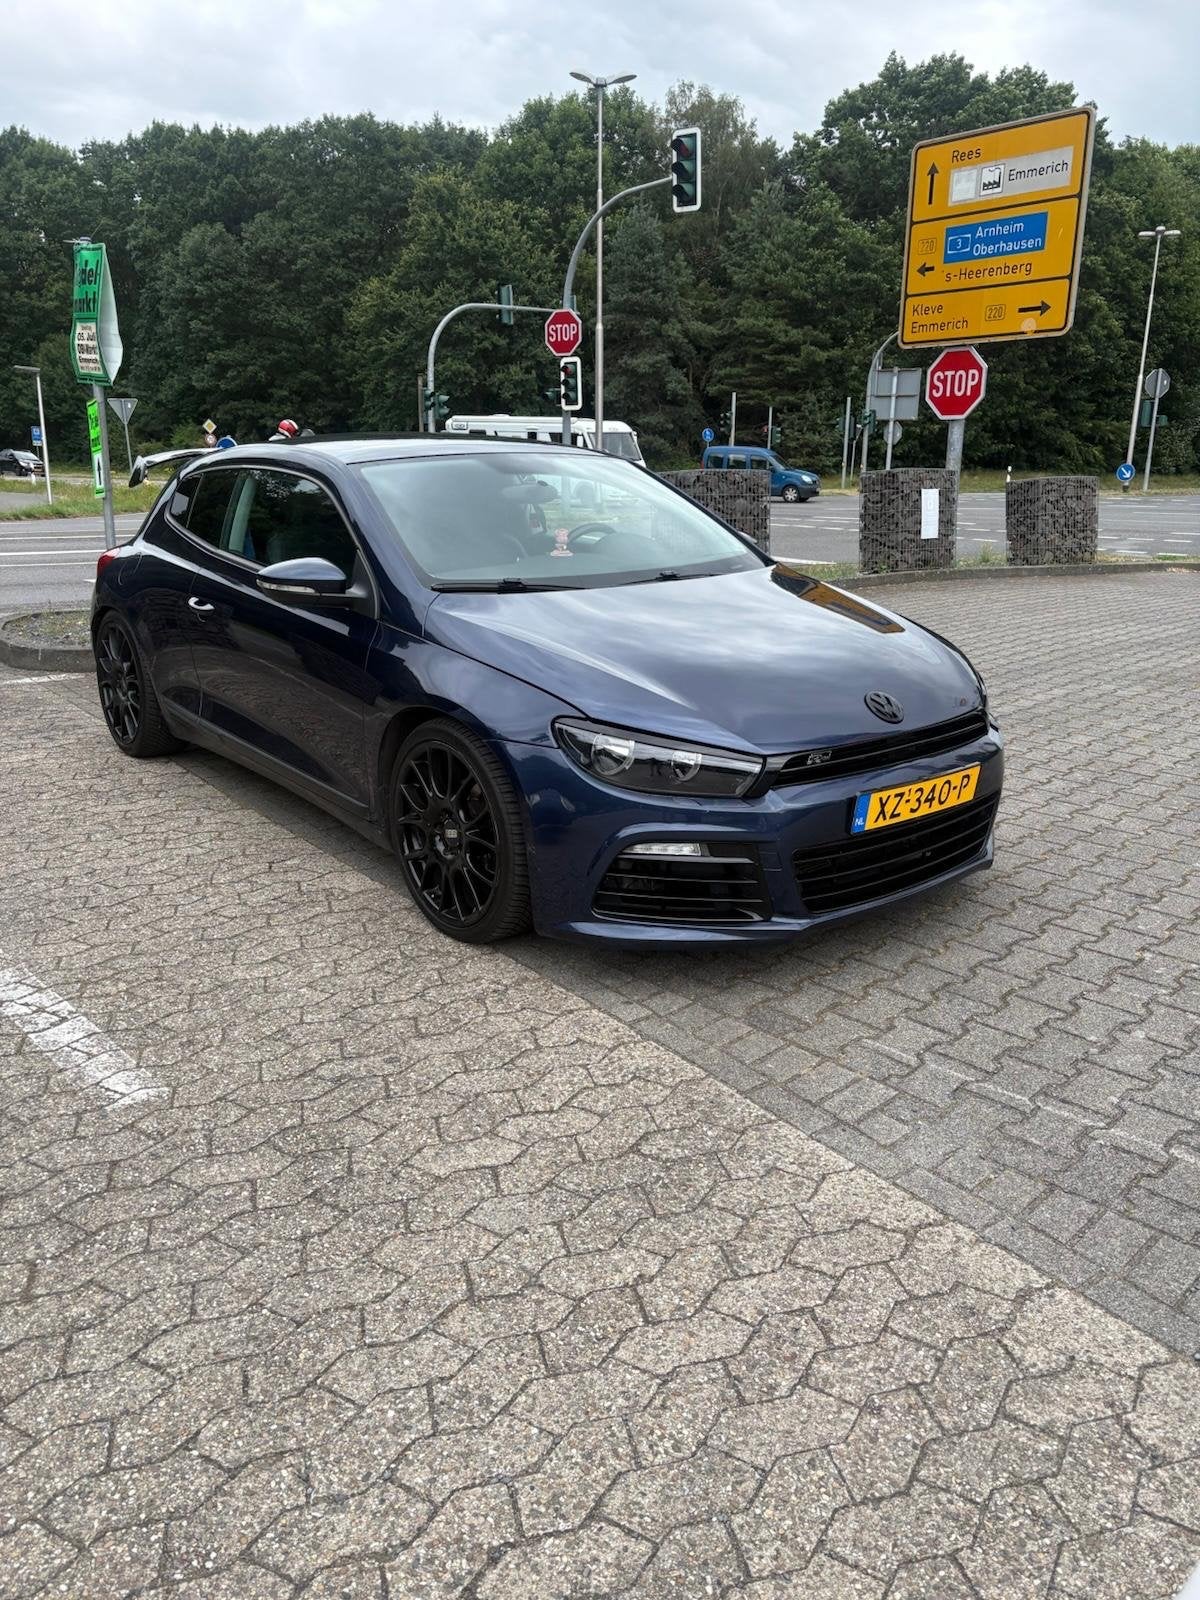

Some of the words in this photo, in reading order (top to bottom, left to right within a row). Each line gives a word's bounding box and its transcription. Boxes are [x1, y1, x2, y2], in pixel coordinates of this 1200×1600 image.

[951, 148, 982, 164] Rees
[1008, 159, 1069, 182] Emmerich
[975, 220, 1025, 239] Arnheim
[955, 238, 962, 249] 3
[972, 237, 1042, 257] Oberhausen
[912, 303, 944, 317] Kleve
[987, 305, 1004, 319] 220
[548, 323, 578, 343] STOP
[911, 317, 969, 335] Emmerich
[931, 368, 980, 398] STOP
[854, 817, 865, 827] NL
